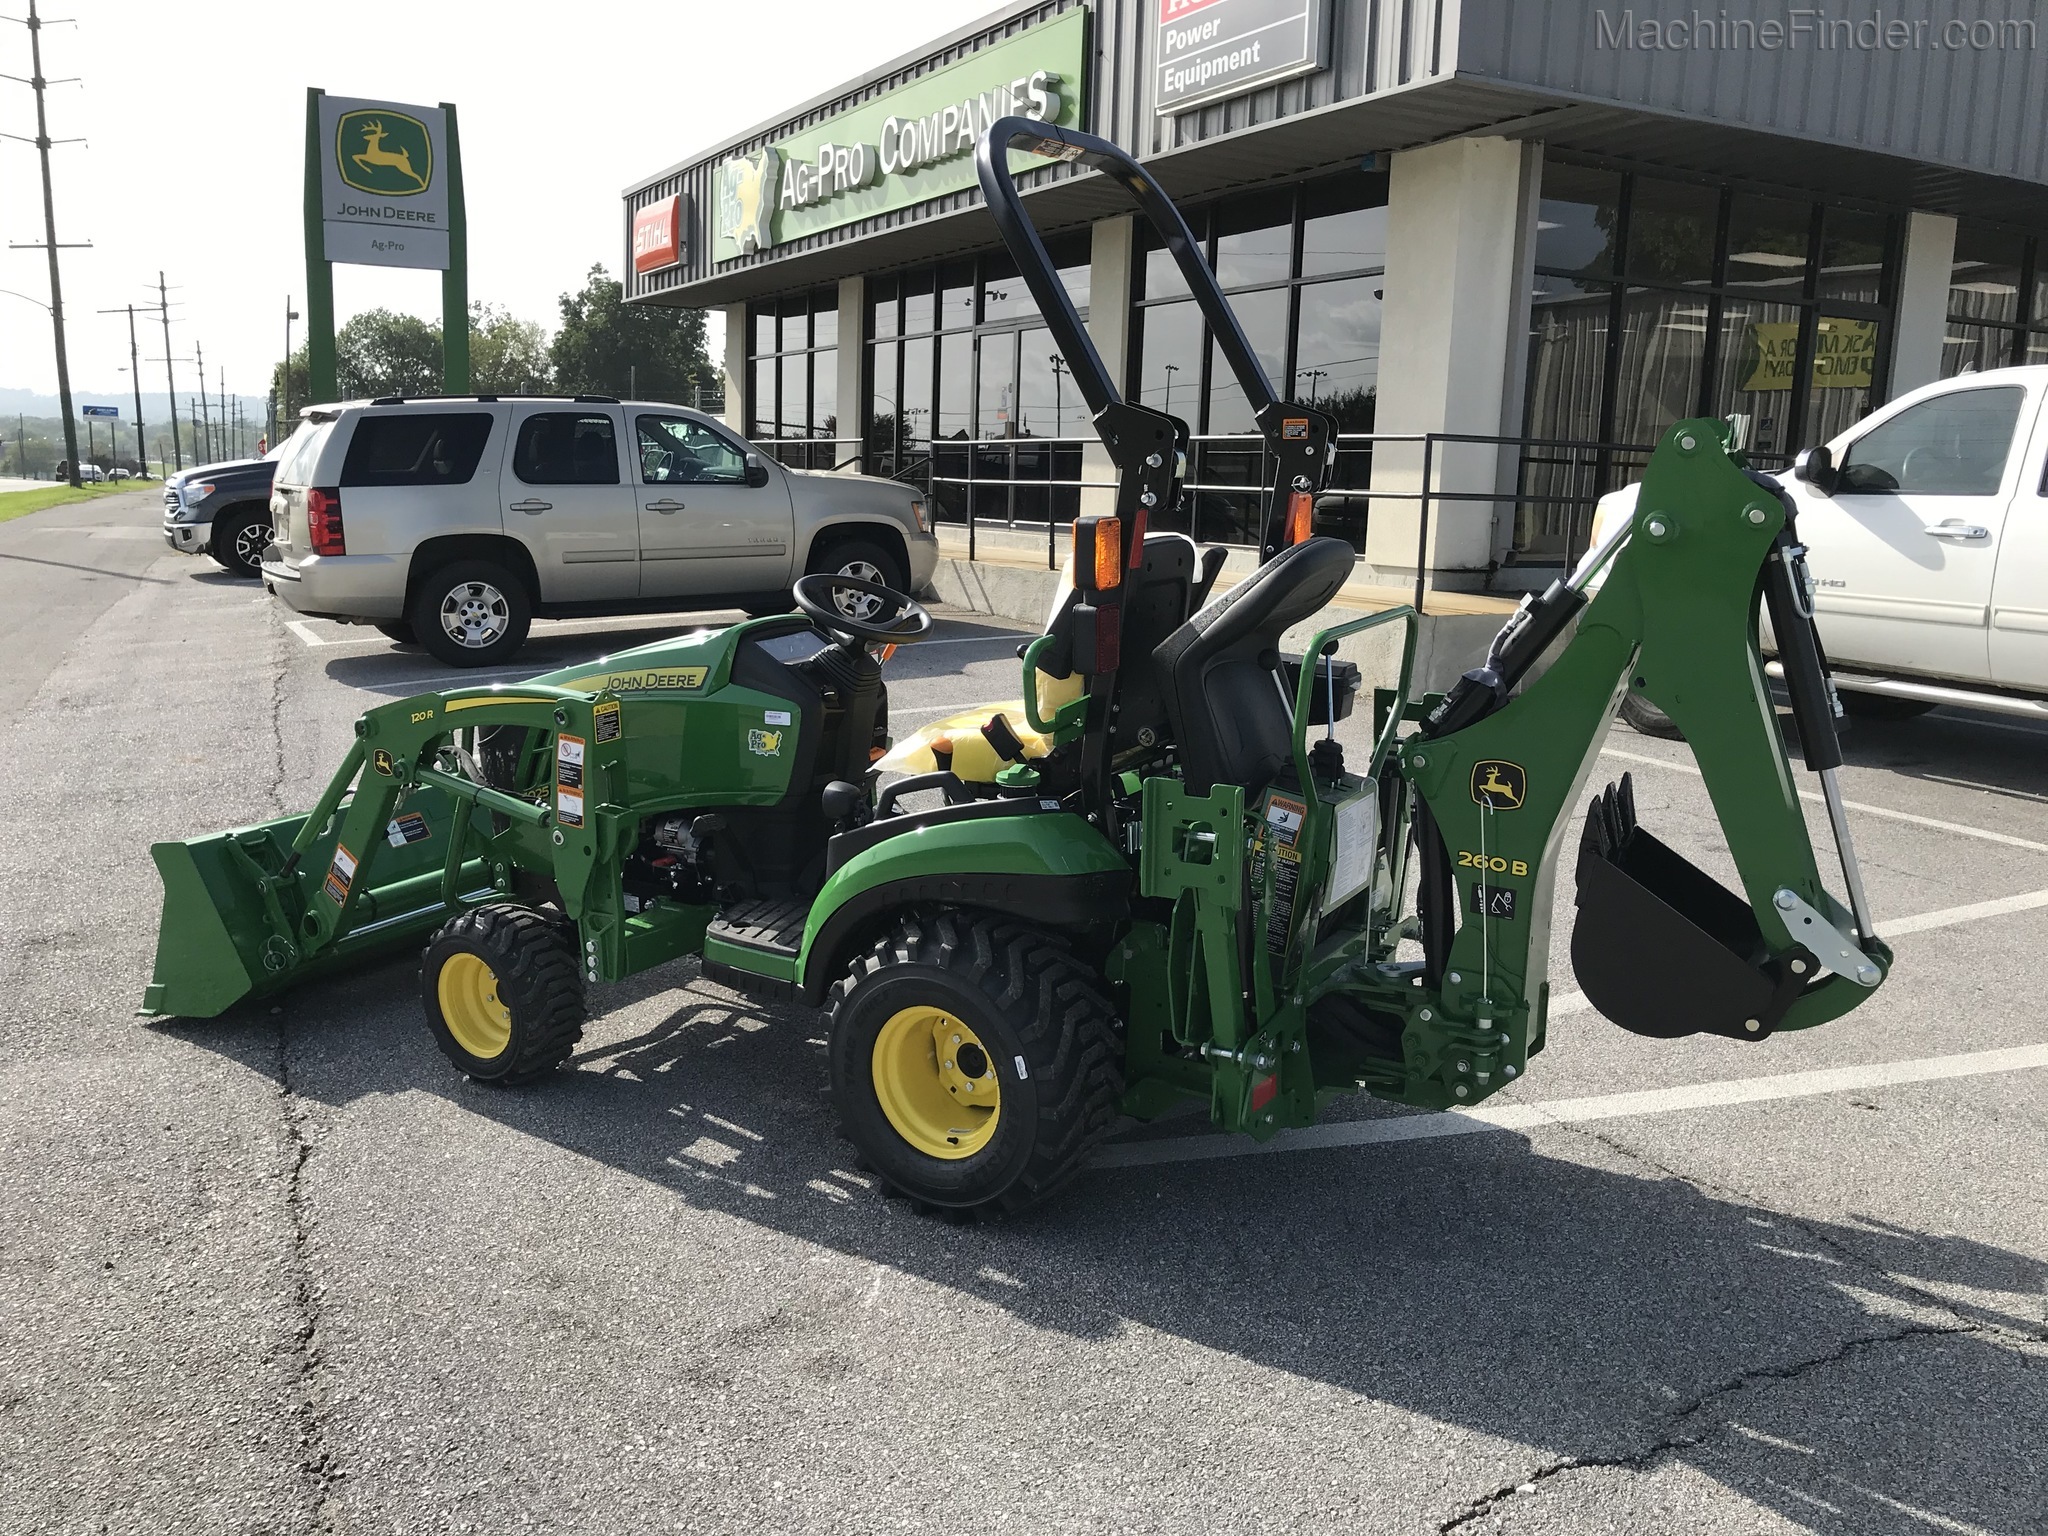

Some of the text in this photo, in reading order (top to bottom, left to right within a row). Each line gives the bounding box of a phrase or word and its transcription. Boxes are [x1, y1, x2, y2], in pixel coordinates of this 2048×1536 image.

[1165, 17, 1221, 54] Power
[1164, 40, 1261, 93] Equipment
[337, 203, 436, 223] JOHN DEERE
[371, 239, 405, 251] Ag-Pro
[636, 218, 669, 253] STIHL
[603, 673, 697, 690] JOHN DEERE
[1277, 799, 1305, 815] WARNING
[1458, 851, 1528, 876] 260 B
